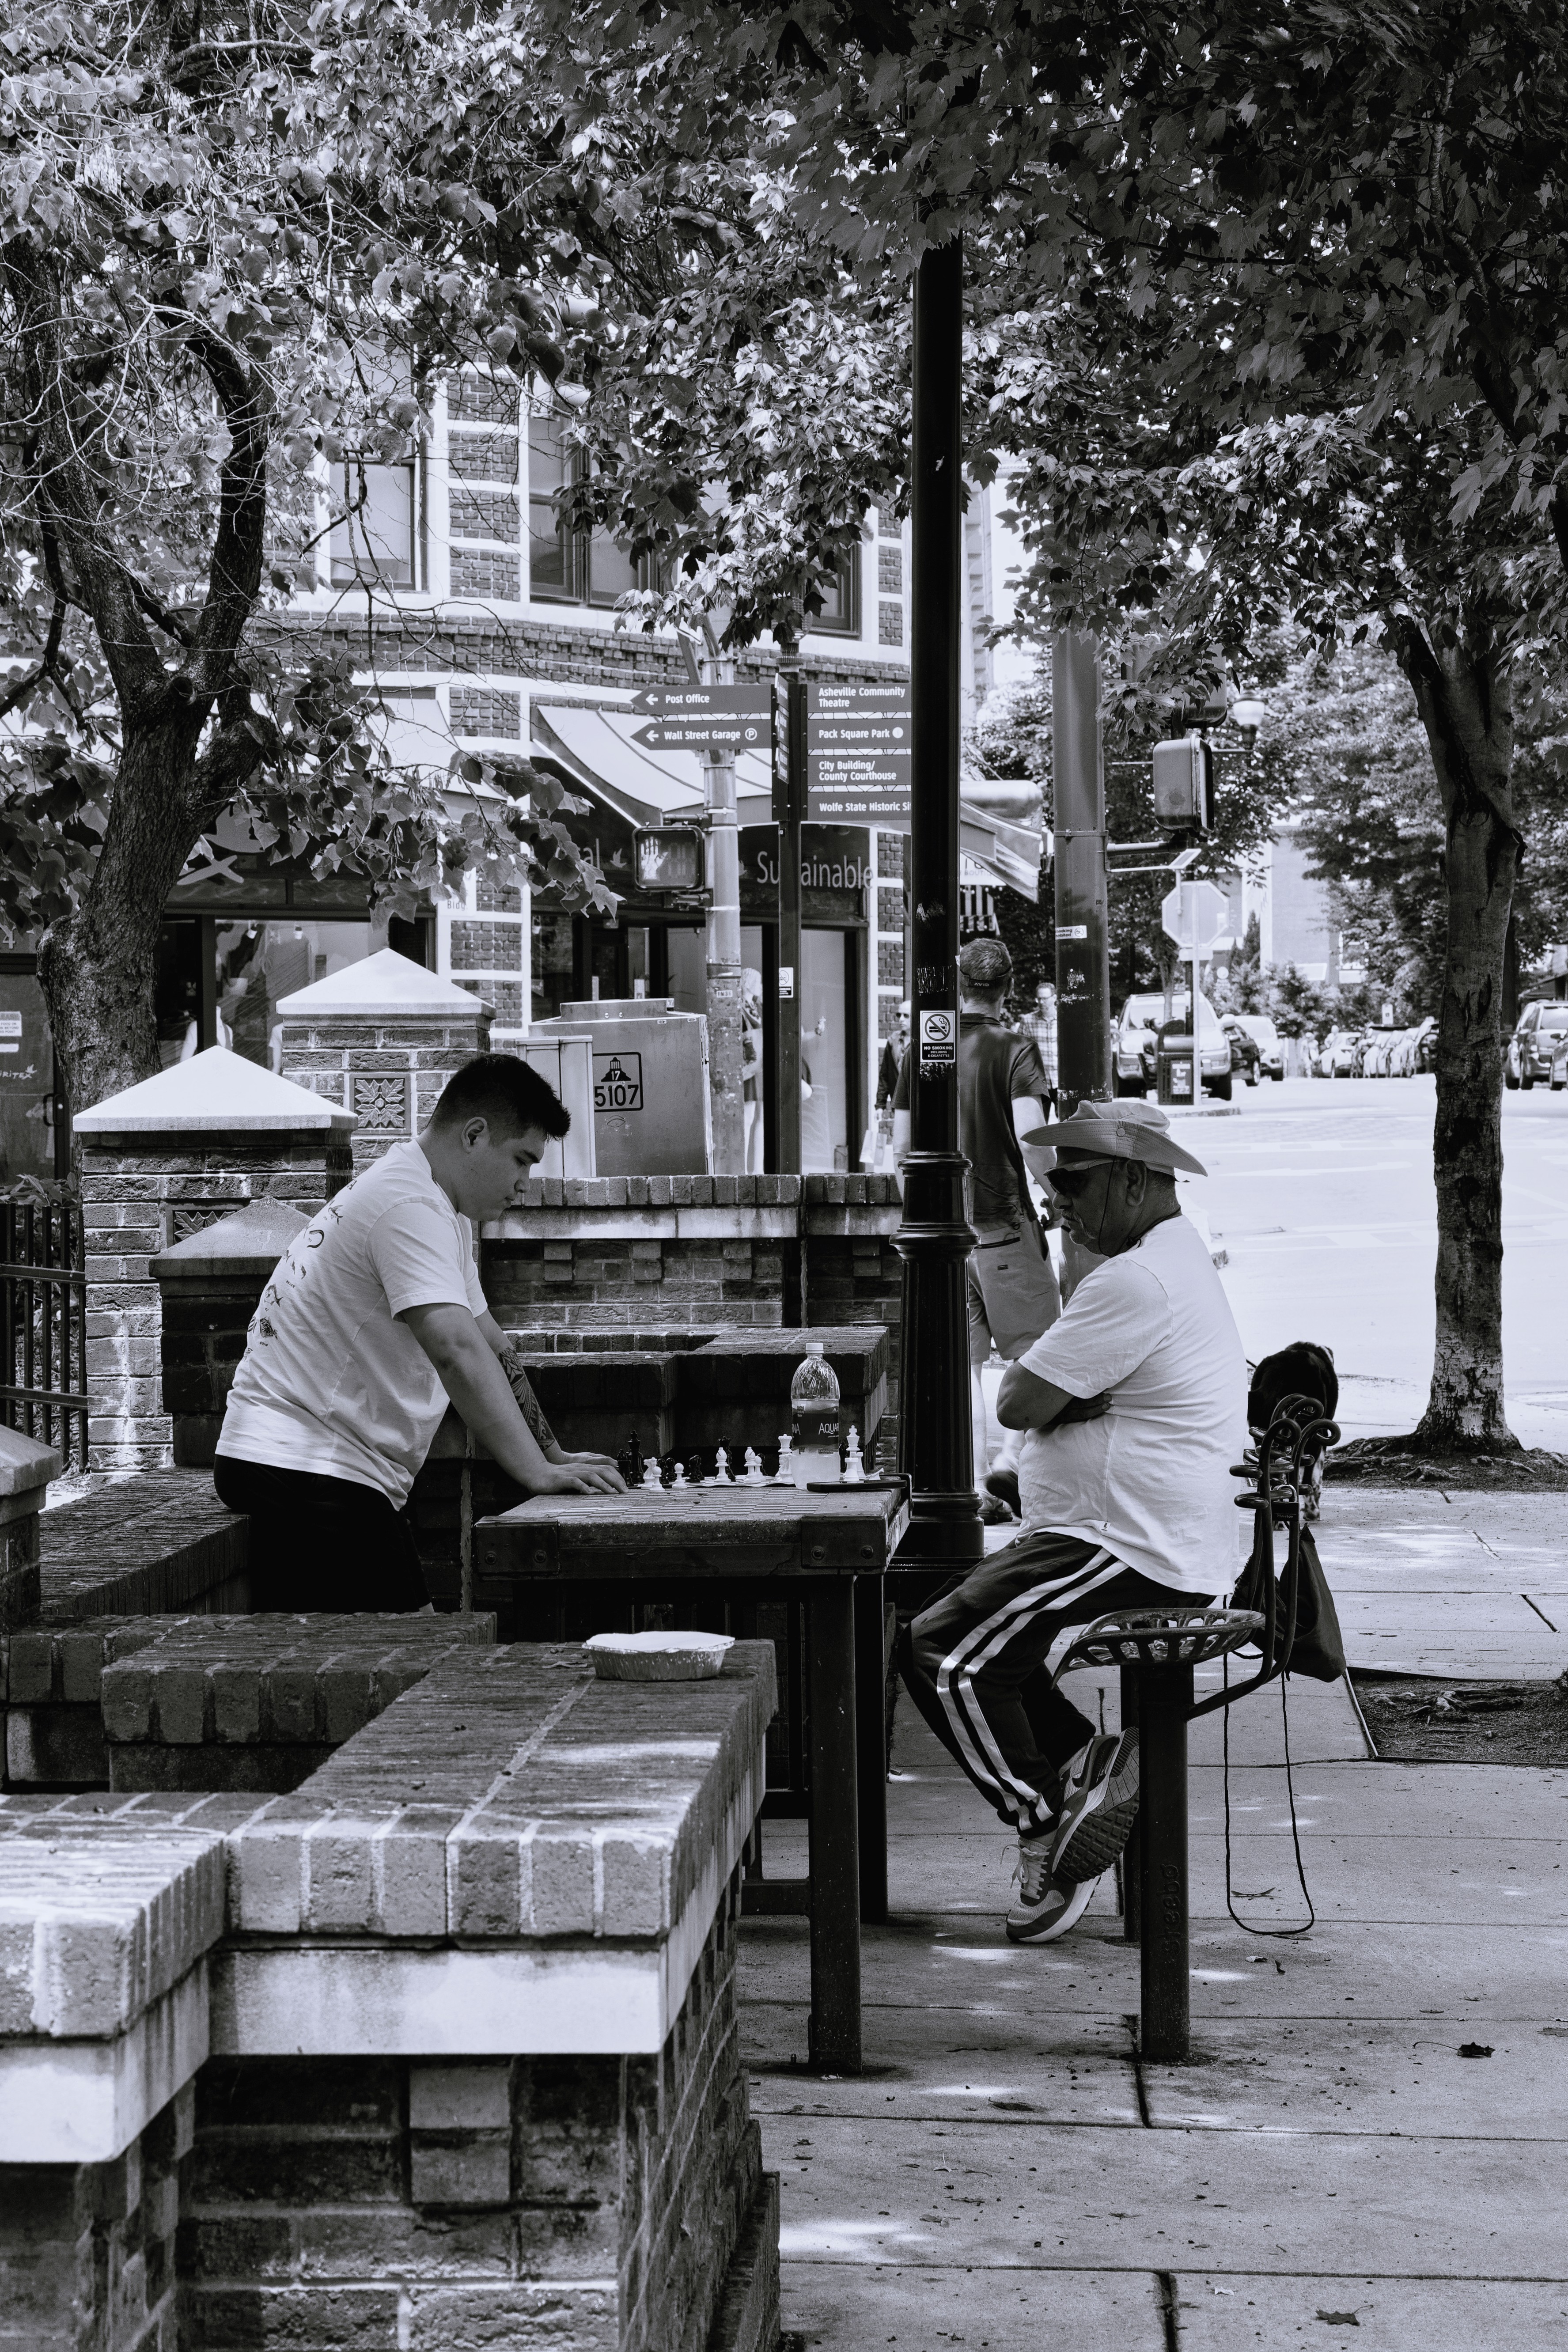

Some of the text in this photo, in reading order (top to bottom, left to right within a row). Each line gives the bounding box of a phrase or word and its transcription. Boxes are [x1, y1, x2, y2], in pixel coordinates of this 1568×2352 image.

[818, 686, 905, 698] Asheville Community
[665, 694, 710, 704] Post Office
[818, 698, 850, 707] Theatre
[664, 731, 683, 740] Wall
[685, 731, 709, 739] Street
[712, 730, 741, 741] Garage
[818, 729, 890, 740] Pack Square Park
[819, 760, 875, 772] City Building/
[819, 771, 897, 782] County Courthouse
[819, 803, 843, 811] Wolfe
[845, 803, 867, 811] State
[869, 802, 900, 811] Historic
[757, 851, 873, 889] Suainable
[611, 1071, 620, 1081] 17
[595, 1084, 639, 1107] 5107
